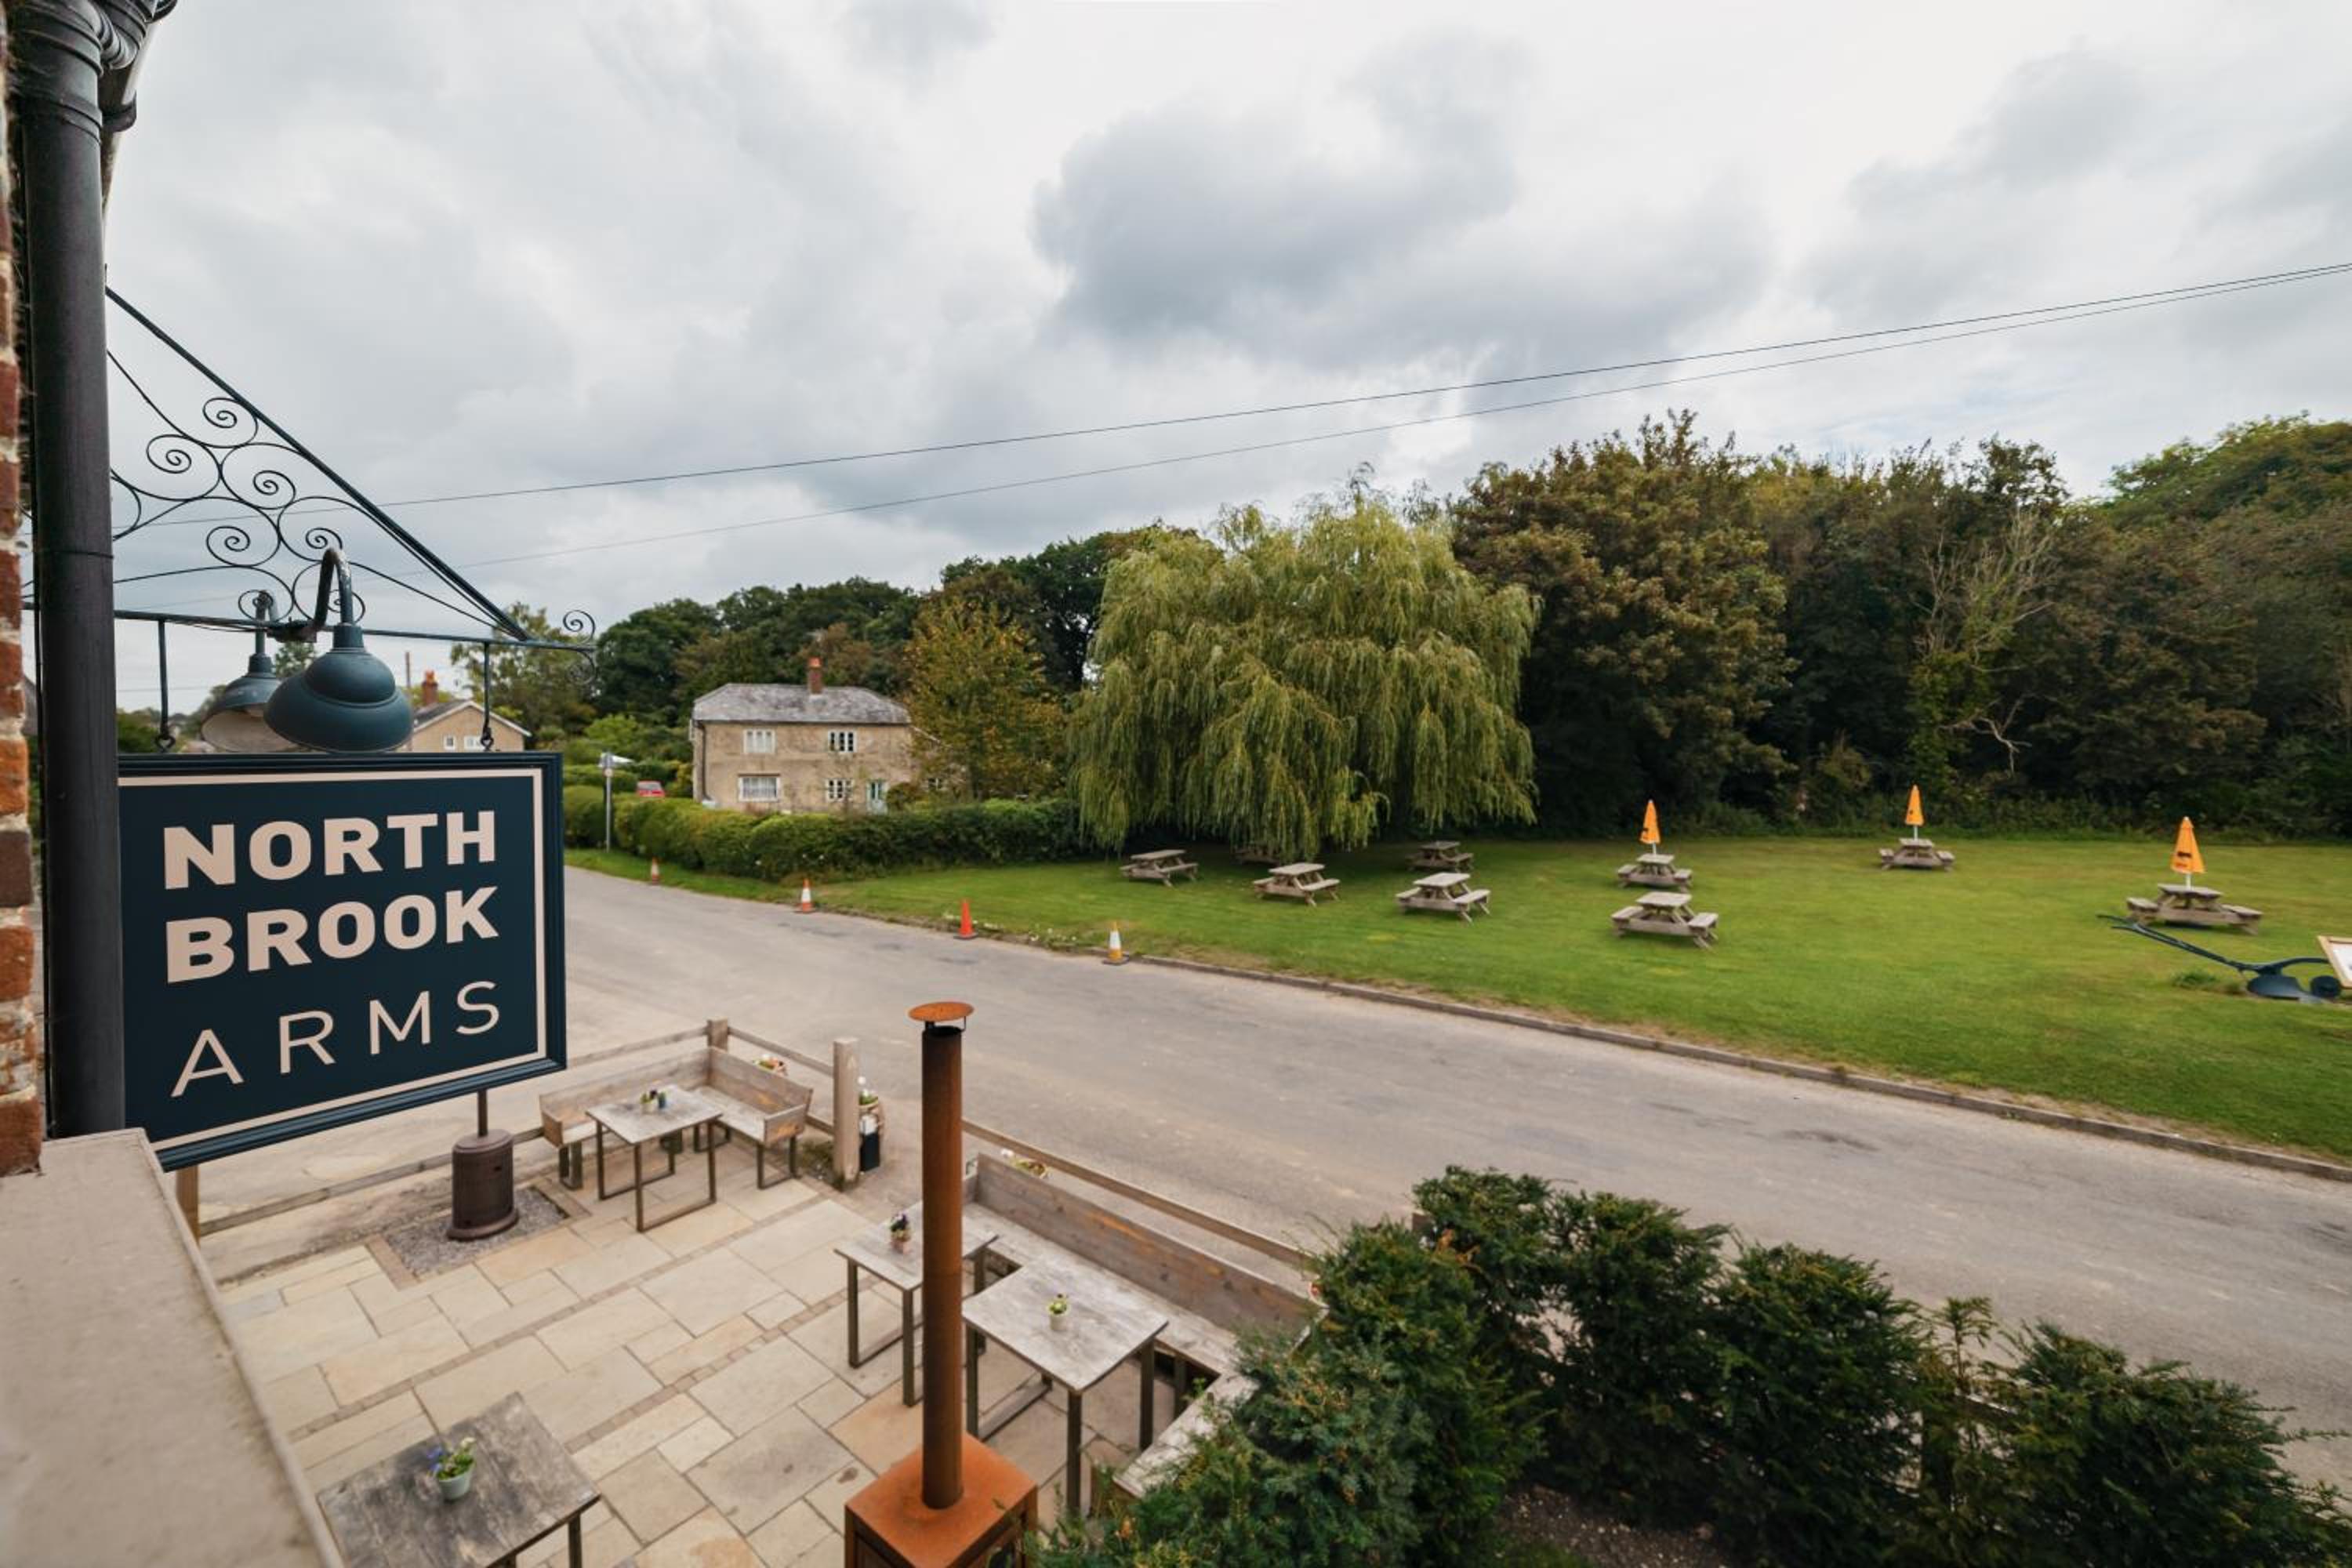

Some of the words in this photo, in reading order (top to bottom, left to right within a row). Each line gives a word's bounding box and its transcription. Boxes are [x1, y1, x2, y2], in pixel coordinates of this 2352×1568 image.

[164, 810, 495, 890] NORTH
[166, 886, 499, 983] BROOK
[170, 981, 500, 1098] ARMS
